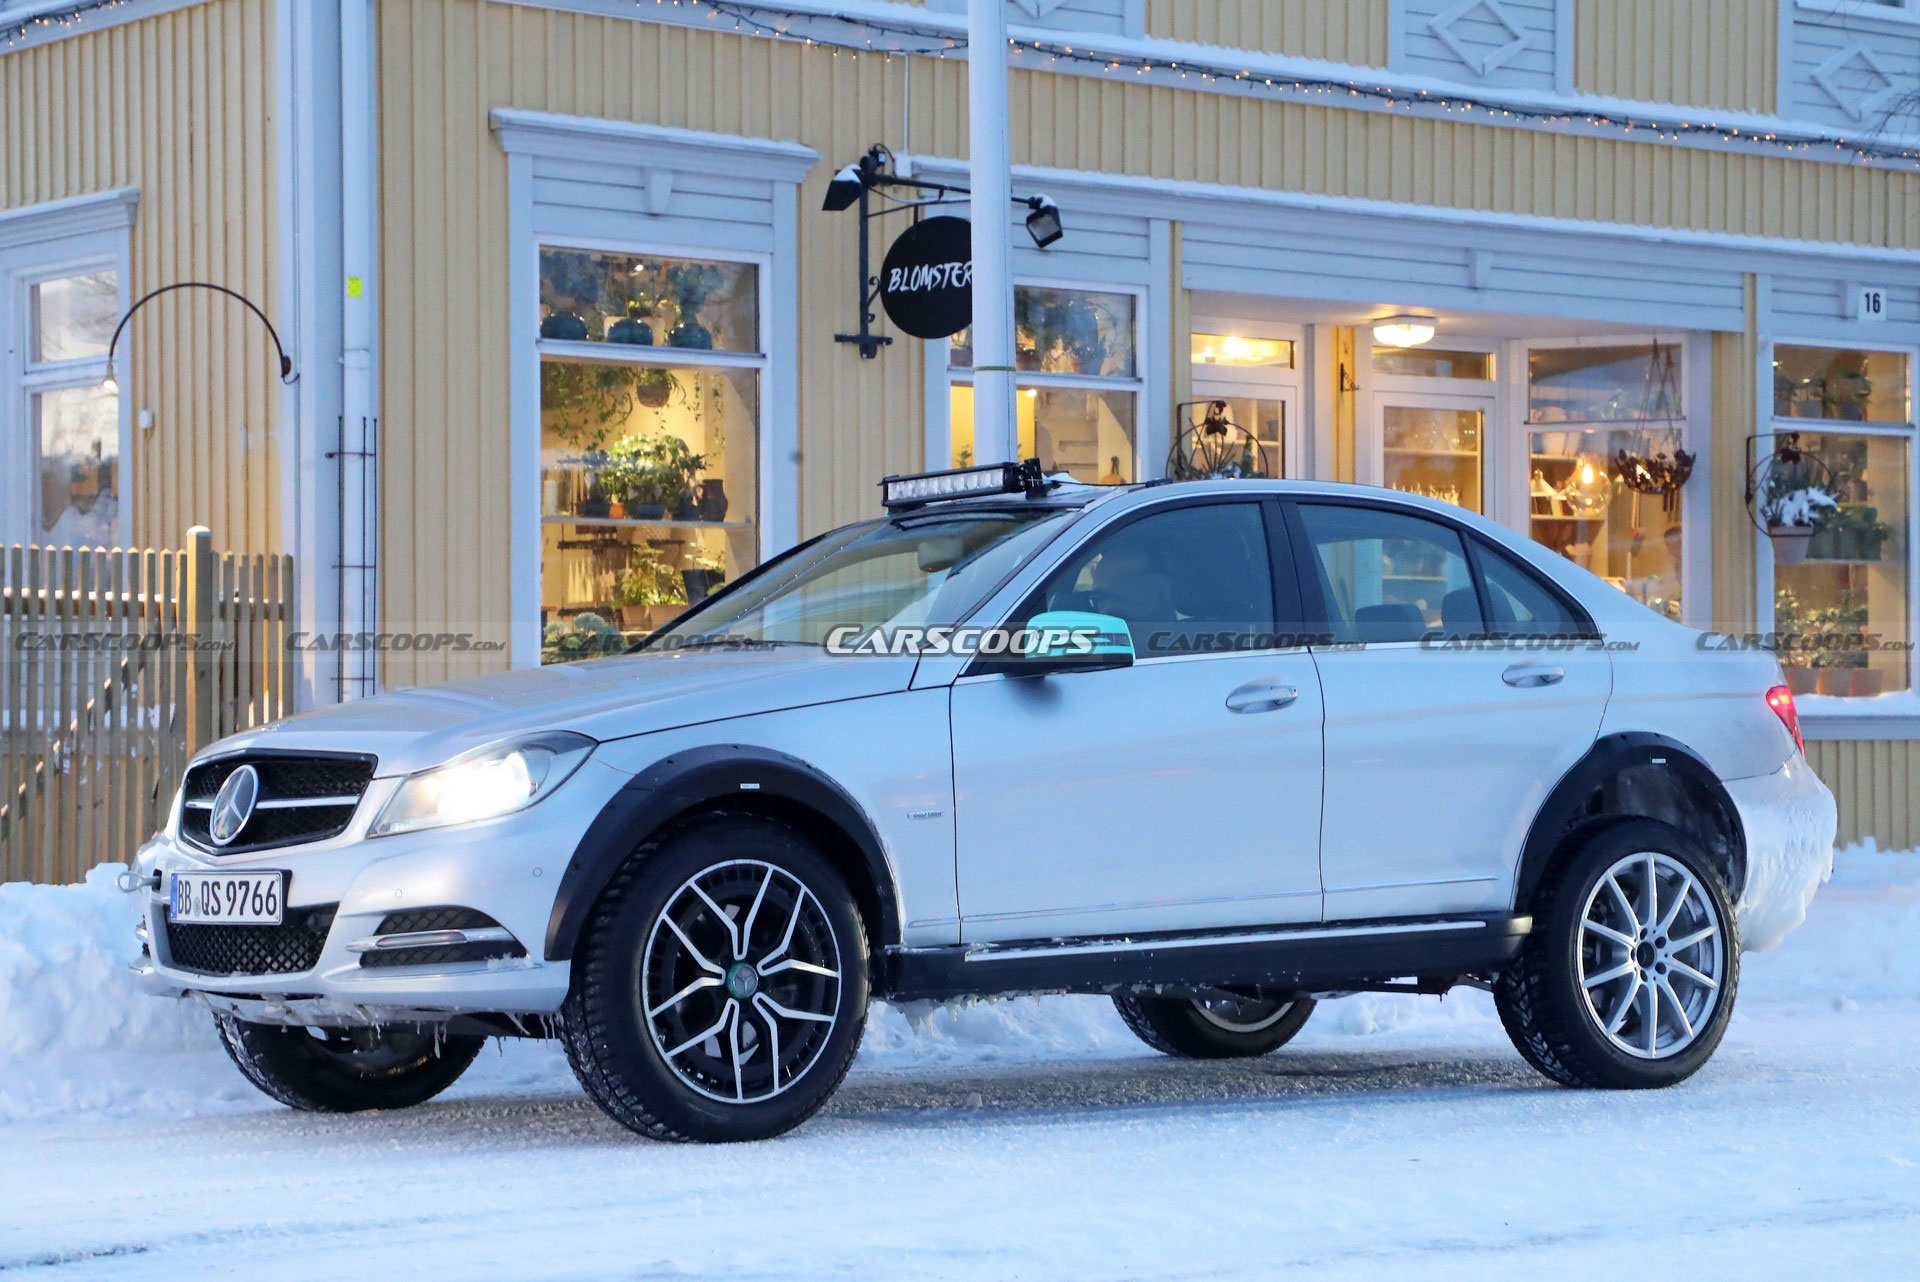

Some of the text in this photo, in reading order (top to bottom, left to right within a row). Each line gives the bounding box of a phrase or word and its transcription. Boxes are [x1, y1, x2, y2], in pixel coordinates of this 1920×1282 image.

[1864, 292, 1881, 314] 16
[177, 880, 277, 916] BB QS 9766
